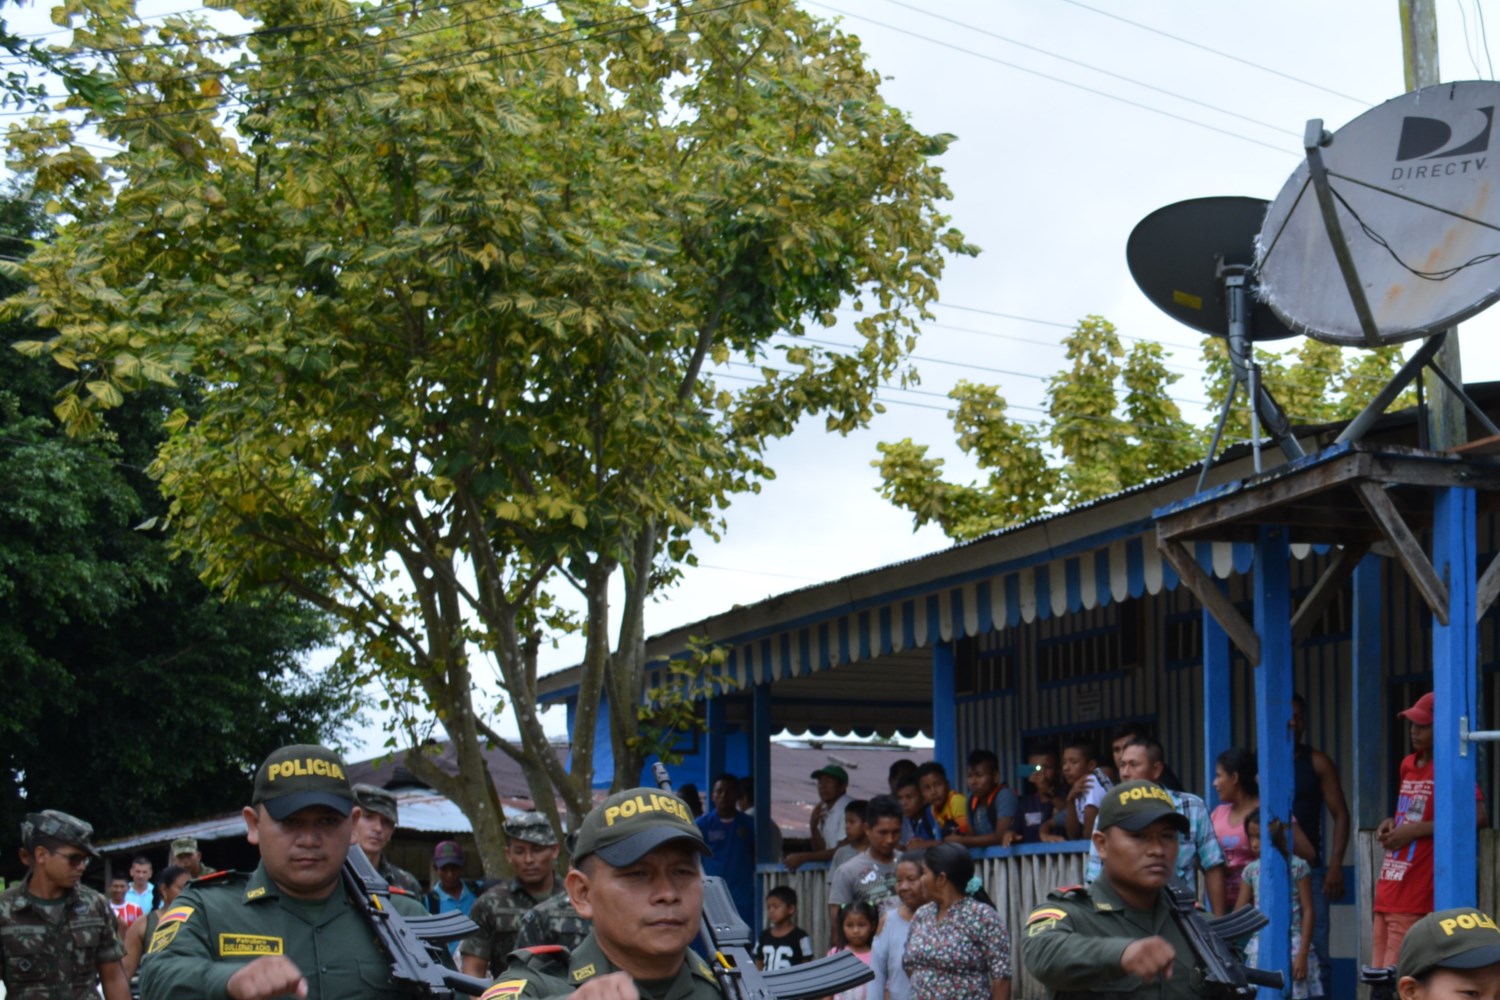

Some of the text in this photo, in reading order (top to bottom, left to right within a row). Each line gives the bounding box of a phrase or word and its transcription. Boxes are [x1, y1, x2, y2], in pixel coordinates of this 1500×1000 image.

[1391, 157, 1487, 181] DIRECTV
[268, 758, 345, 781] POLICIA
[605, 794, 692, 826] POLICIA
[1119, 786, 1175, 811] POLIC
